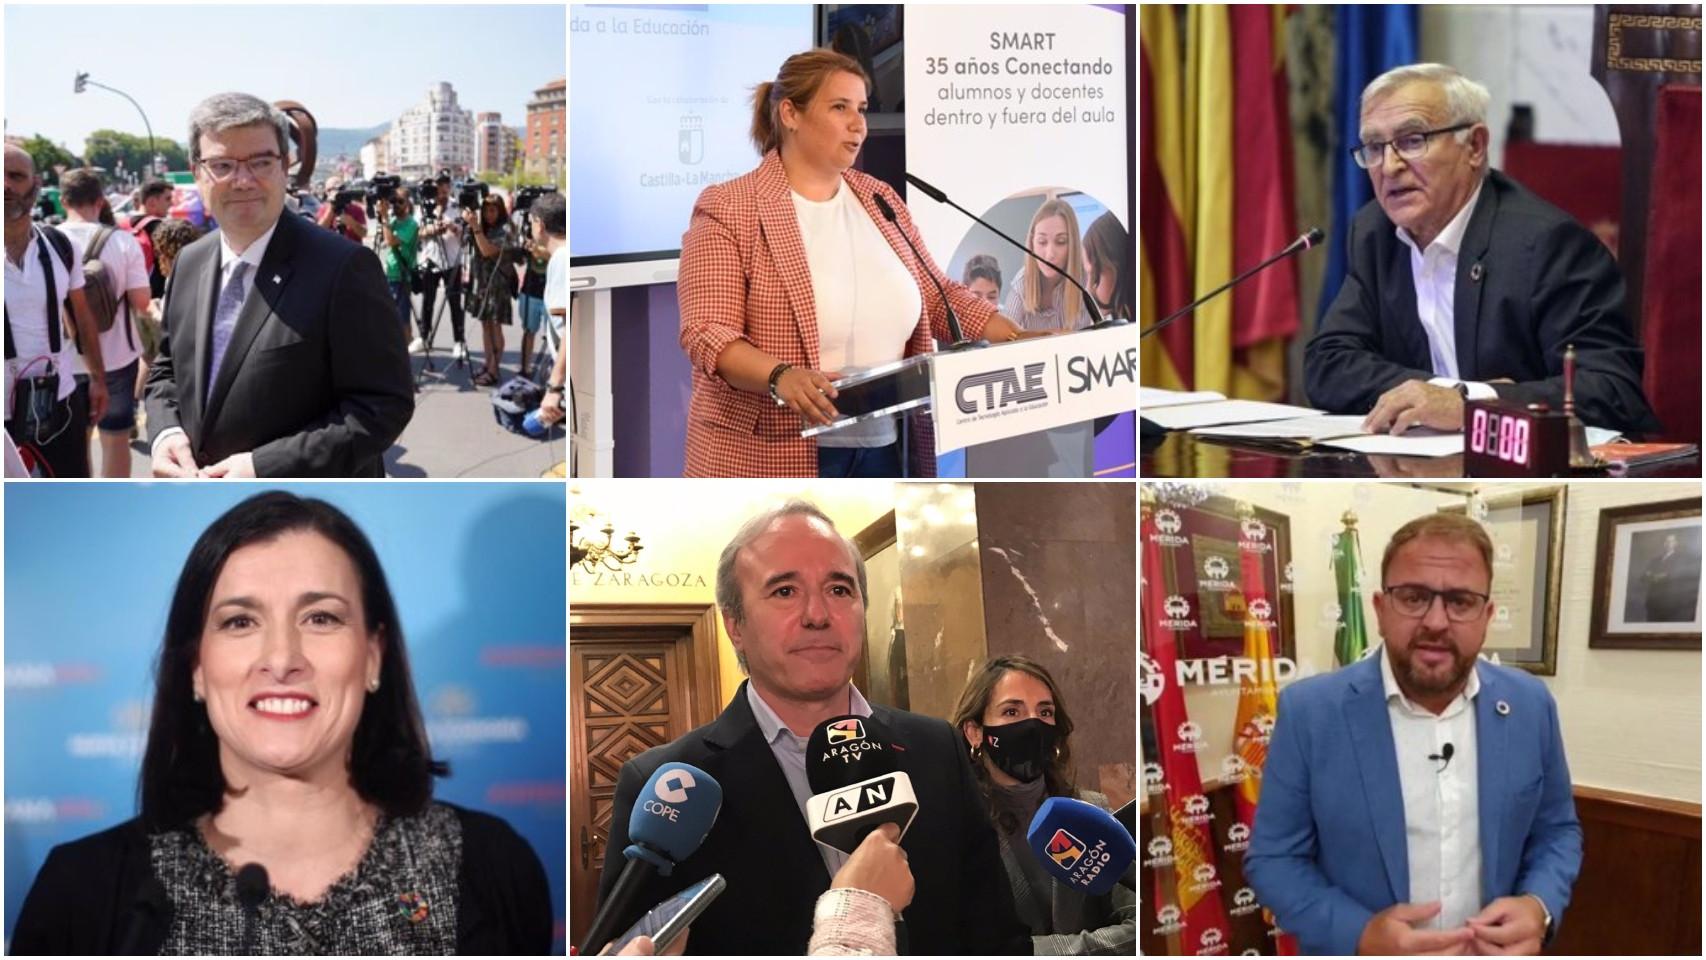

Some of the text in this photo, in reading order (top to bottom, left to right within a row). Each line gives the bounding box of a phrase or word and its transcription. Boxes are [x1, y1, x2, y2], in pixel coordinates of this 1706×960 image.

[596, 20, 606, 33] a
[612, 17, 628, 34] la
[633, 18, 710, 36] Educación
[990, 32, 1056, 50] SMART
[925, 57, 1113, 75] 35 años Conectando
[938, 82, 1104, 104] alumnos y docentes
[924, 106, 1115, 129] dentro y fuera del aula
[955, 362, 1048, 414] CTAE
[594, 572, 706, 587] ZARAGOZA
[822, 740, 883, 763] ARAGÓN
[842, 751, 862, 764] TV
[643, 800, 681, 823] COPE
[1070, 839, 1108, 885] ARAGÓN
[1081, 852, 1111, 886] RADIO
